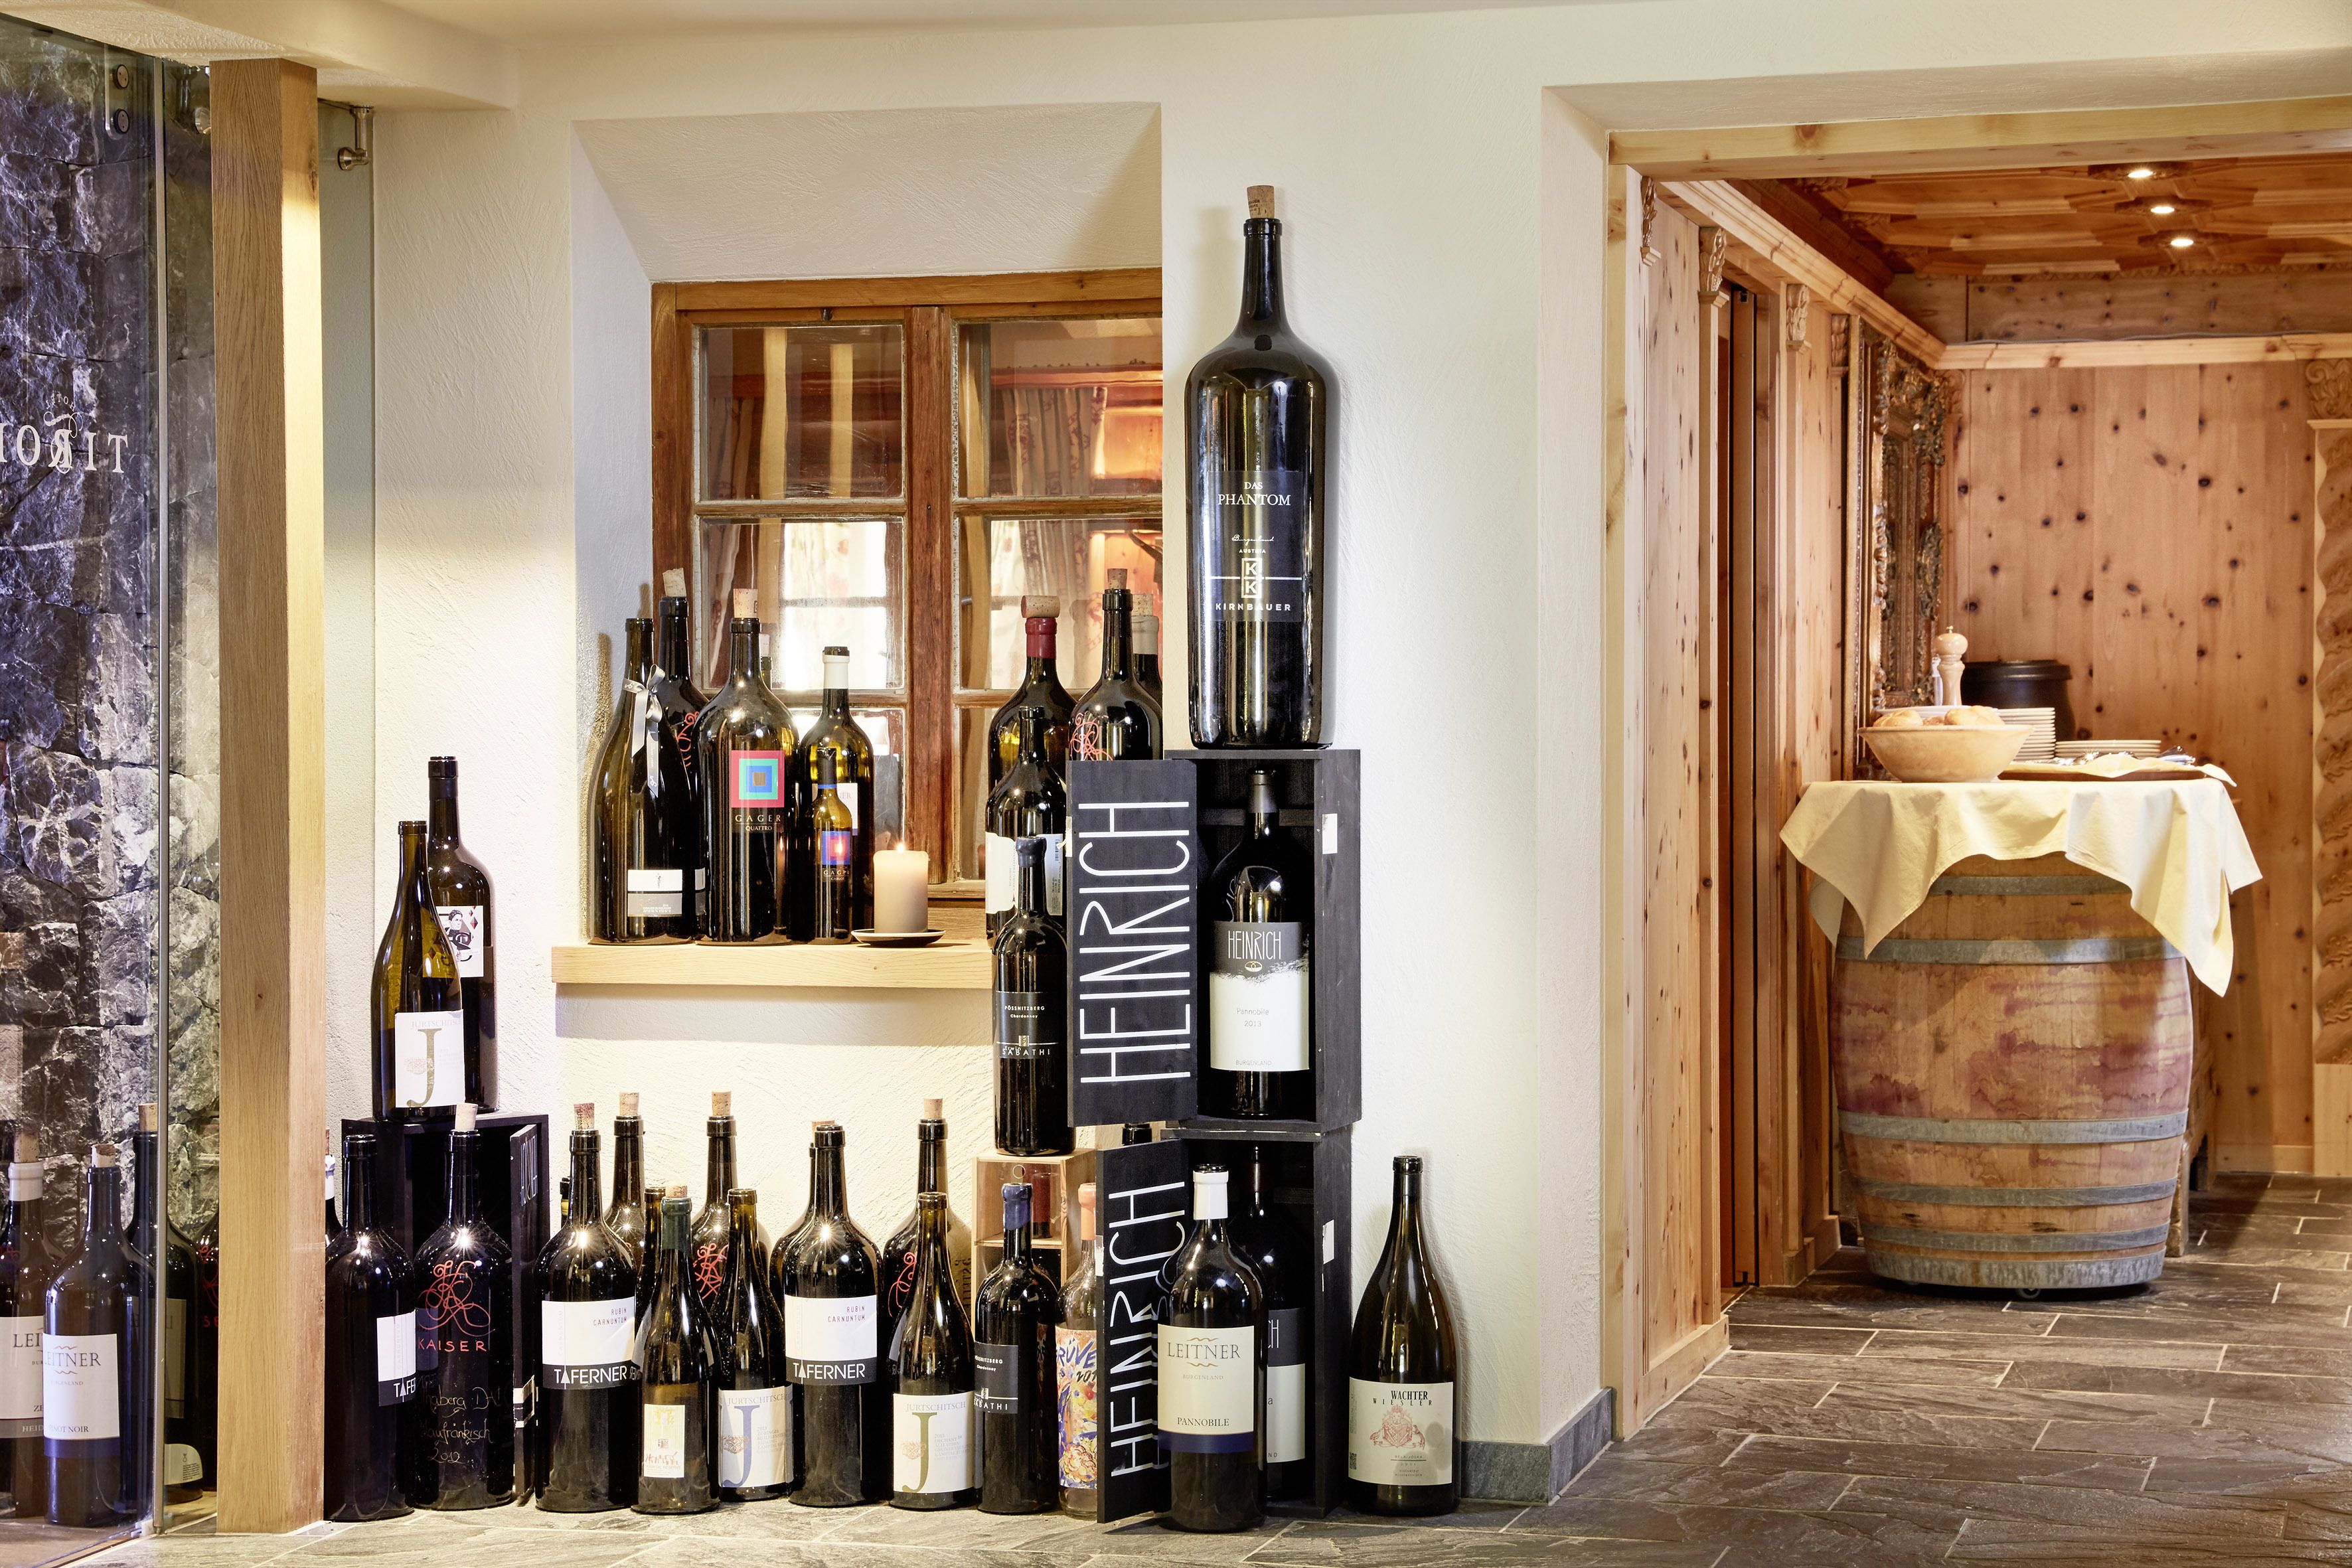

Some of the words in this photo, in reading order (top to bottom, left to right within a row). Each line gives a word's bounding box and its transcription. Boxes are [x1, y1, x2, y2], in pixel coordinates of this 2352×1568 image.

[1217, 495, 1291, 506] PHANTOM
[1215, 603, 1291, 611] KIRNBAUER
[1079, 801, 1190, 1083] HEINRICH
[1228, 931, 1281, 960] HEINRICH
[593, 1316, 627, 1326] CARNUNTUM
[828, 1314, 866, 1322] CARNUNTUM
[418, 1337, 487, 1352] KAISER
[1167, 1342, 1241, 1360] LEITNER
[554, 1366, 627, 1384] TAFERNER
[793, 1363, 866, 1379] TAFERNER
[1391, 1391, 1428, 1400] WACHTER
[905, 1401, 966, 1413] JURTSCHITSCH
[1177, 1417, 1229, 1427] PANNOBILE
